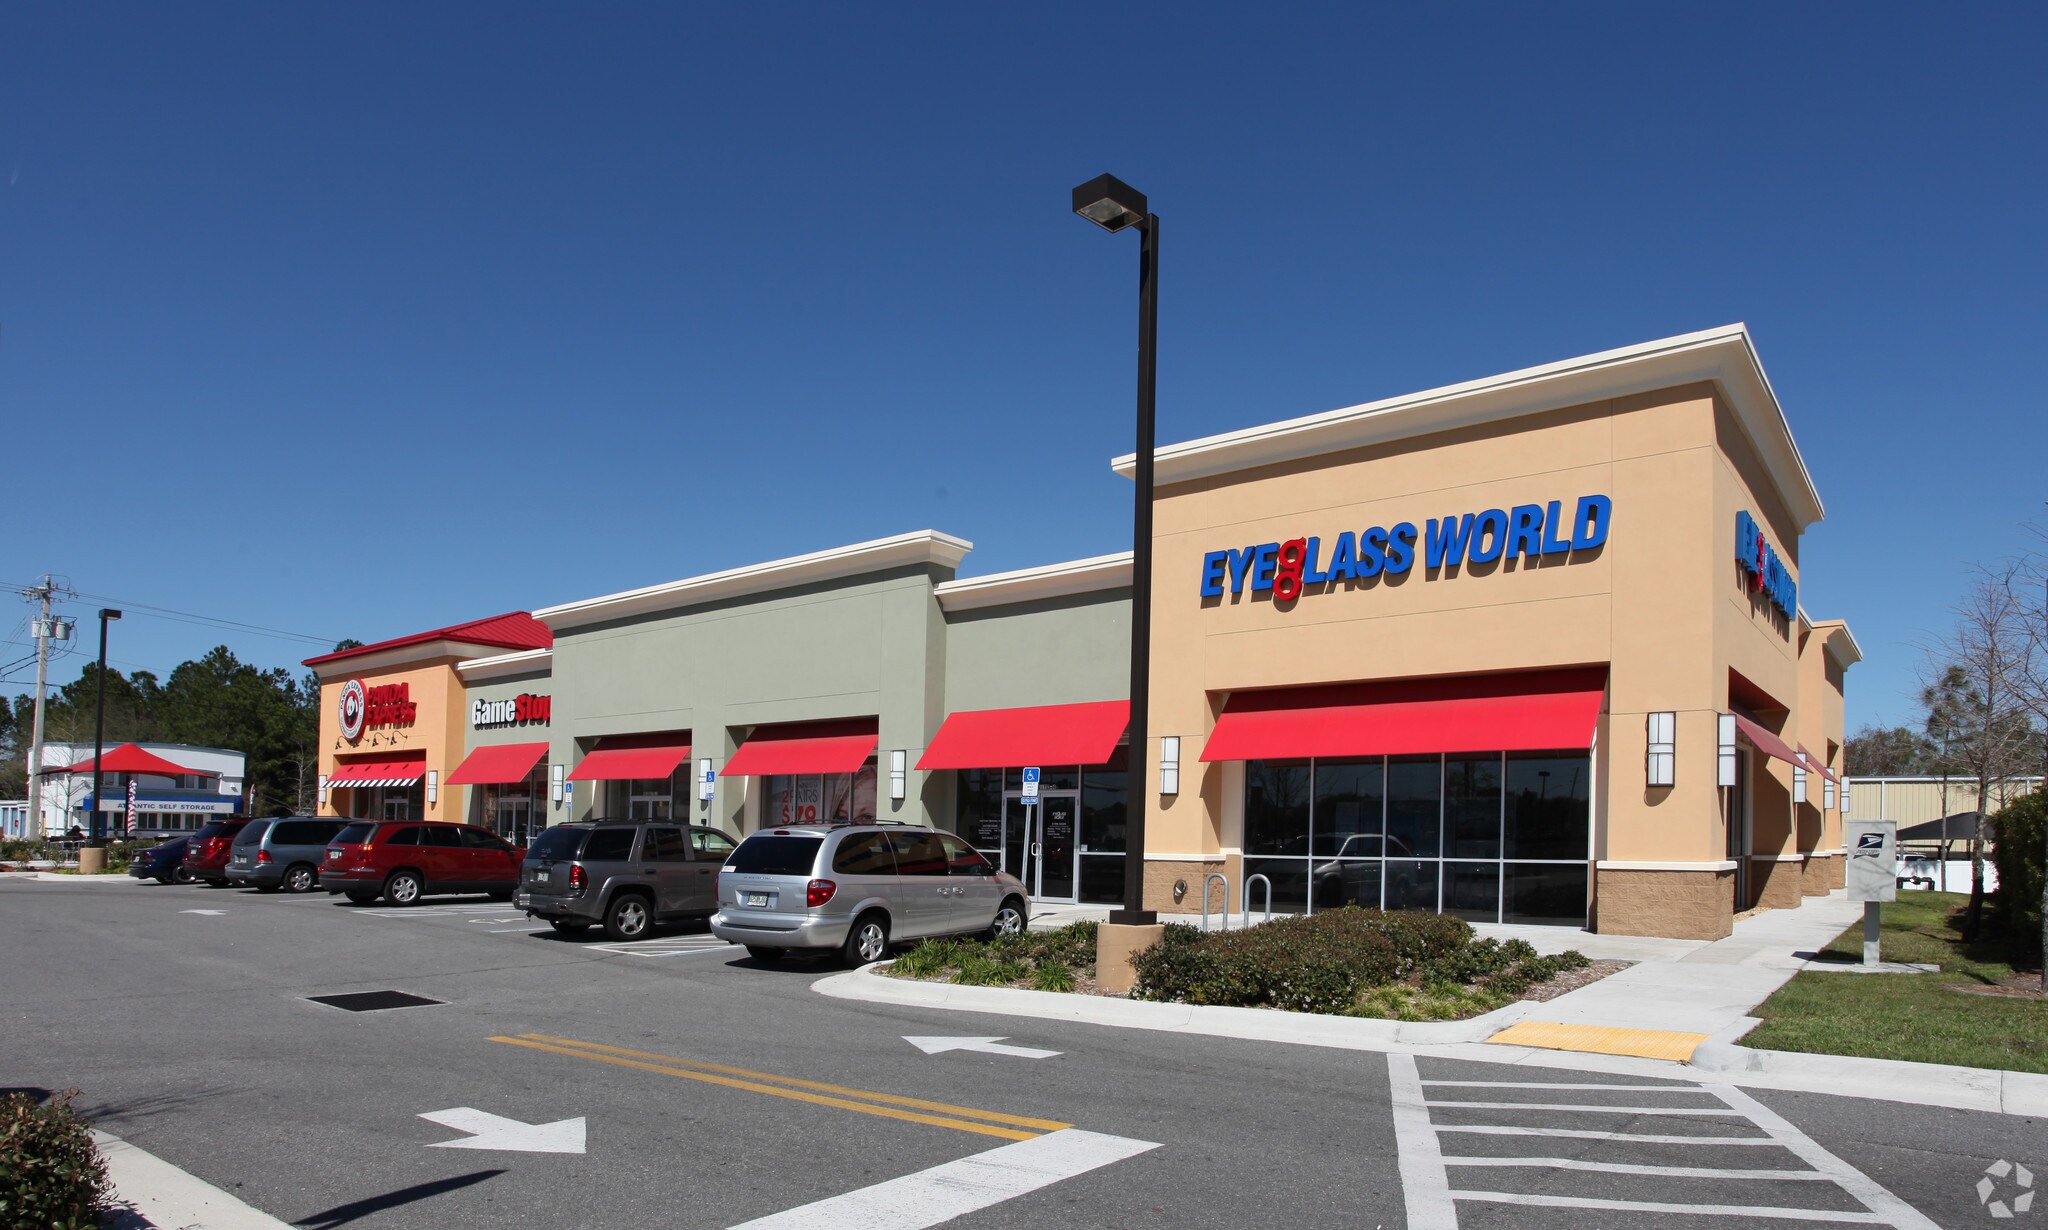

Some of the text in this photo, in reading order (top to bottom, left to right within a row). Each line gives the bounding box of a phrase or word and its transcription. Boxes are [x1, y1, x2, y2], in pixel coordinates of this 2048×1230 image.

[1426, 494, 1612, 568] WORLD
[367, 682, 417, 726] PANDA EXPRESS
